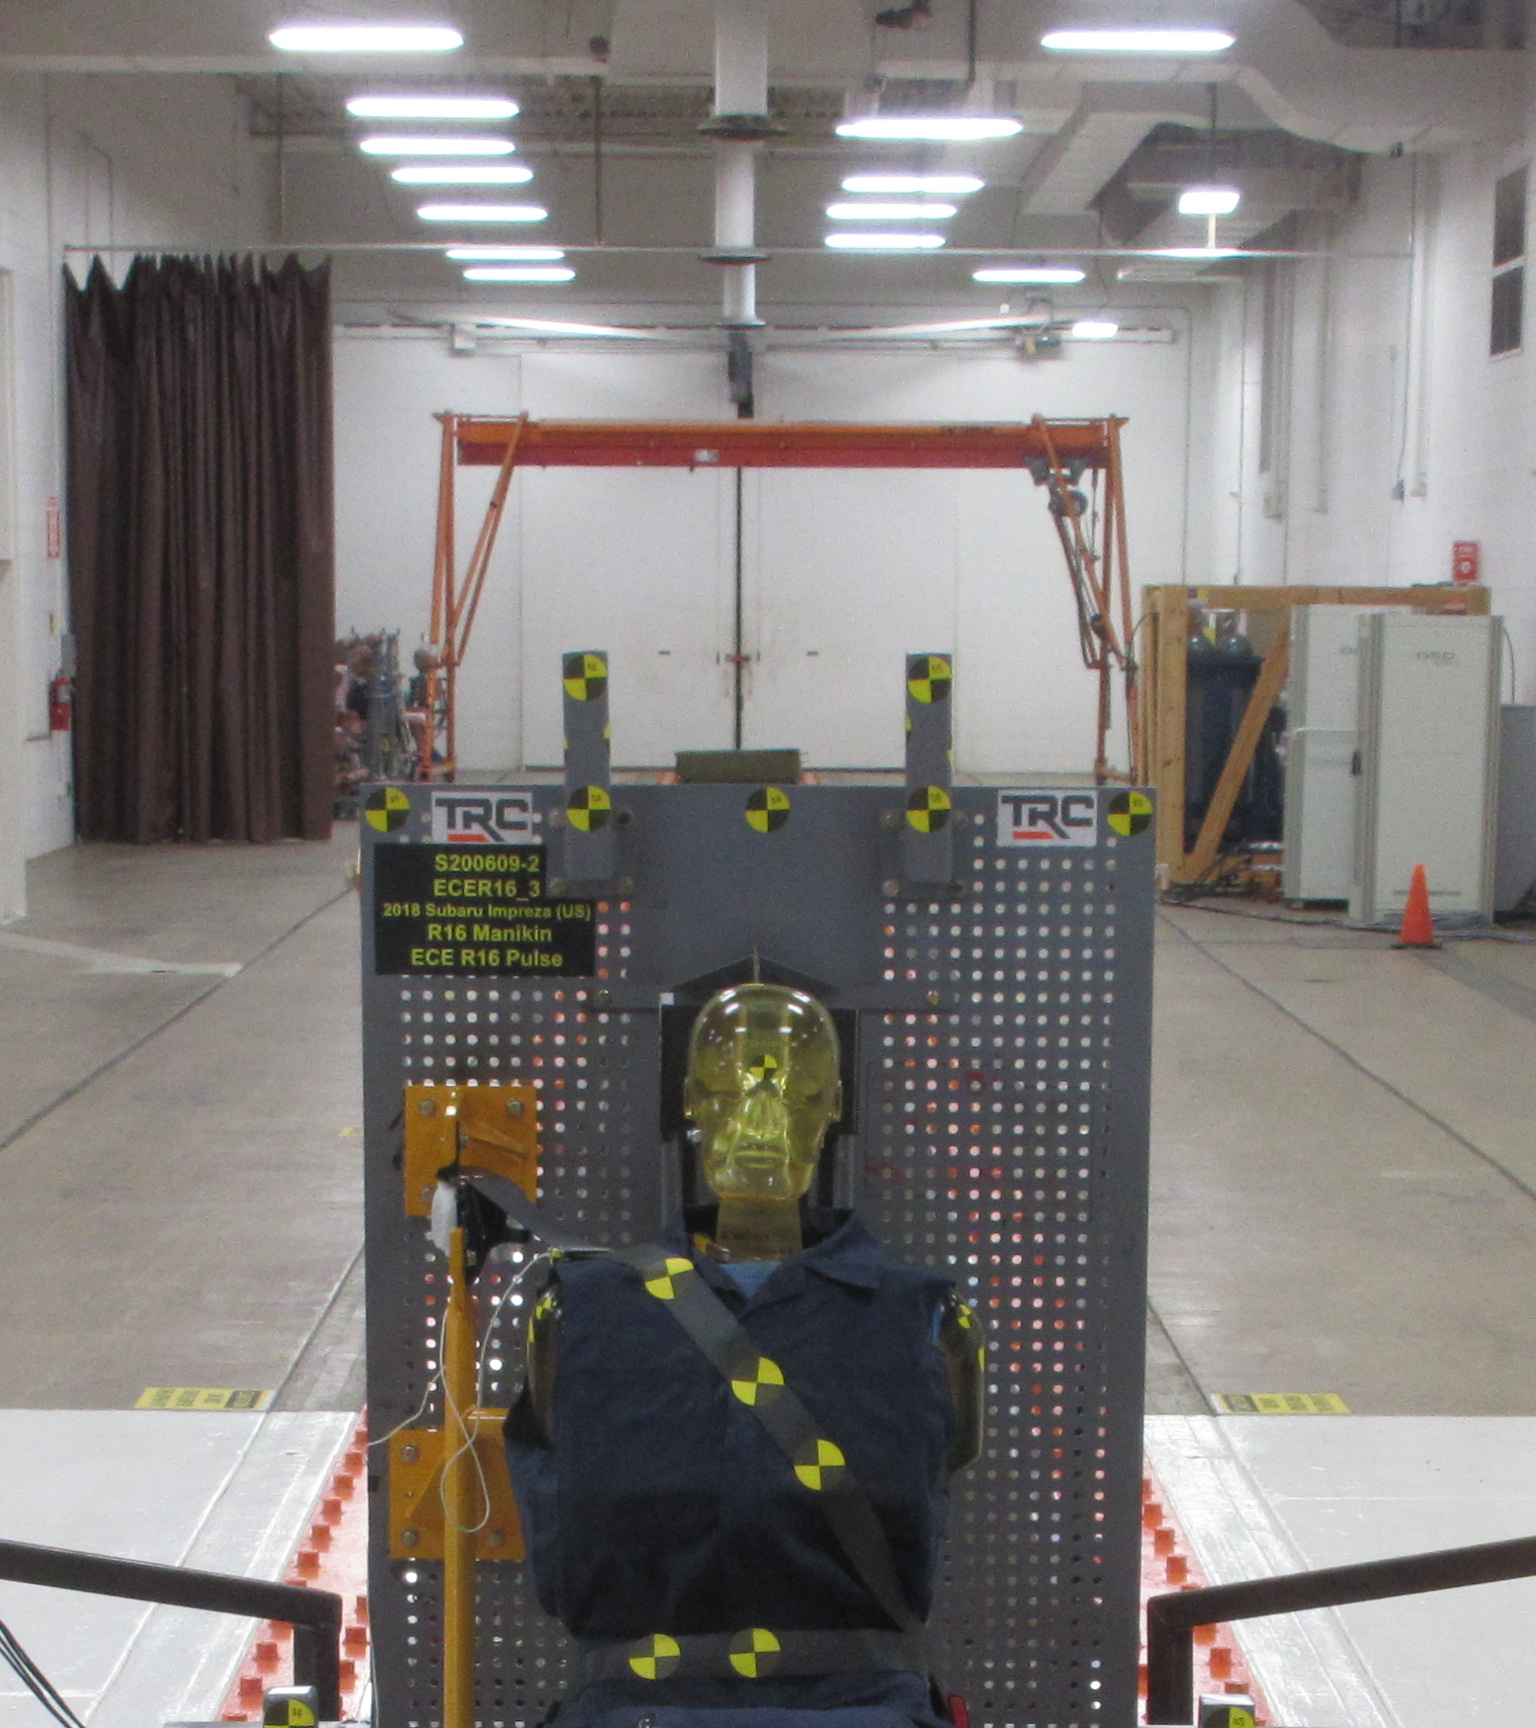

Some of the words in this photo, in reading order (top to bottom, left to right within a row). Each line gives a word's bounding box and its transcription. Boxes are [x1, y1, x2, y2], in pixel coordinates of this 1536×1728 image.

[434, 798, 530, 842] TRC
[1000, 795, 1095, 839] TRC
[434, 854, 540, 872] S200609-2
[433, 879, 541, 902] ECER16_3
[383, 903, 421, 917] 2018
[426, 903, 483, 917] Subaru
[488, 904, 552, 920] Impreza
[556, 904, 592, 921] (US)
[427, 924, 468, 942] R16
[472, 924, 553, 942] Manikin
[410, 949, 455, 967] ECE
[461, 949, 500, 967] R16
[506, 949, 564, 967] Pulse
